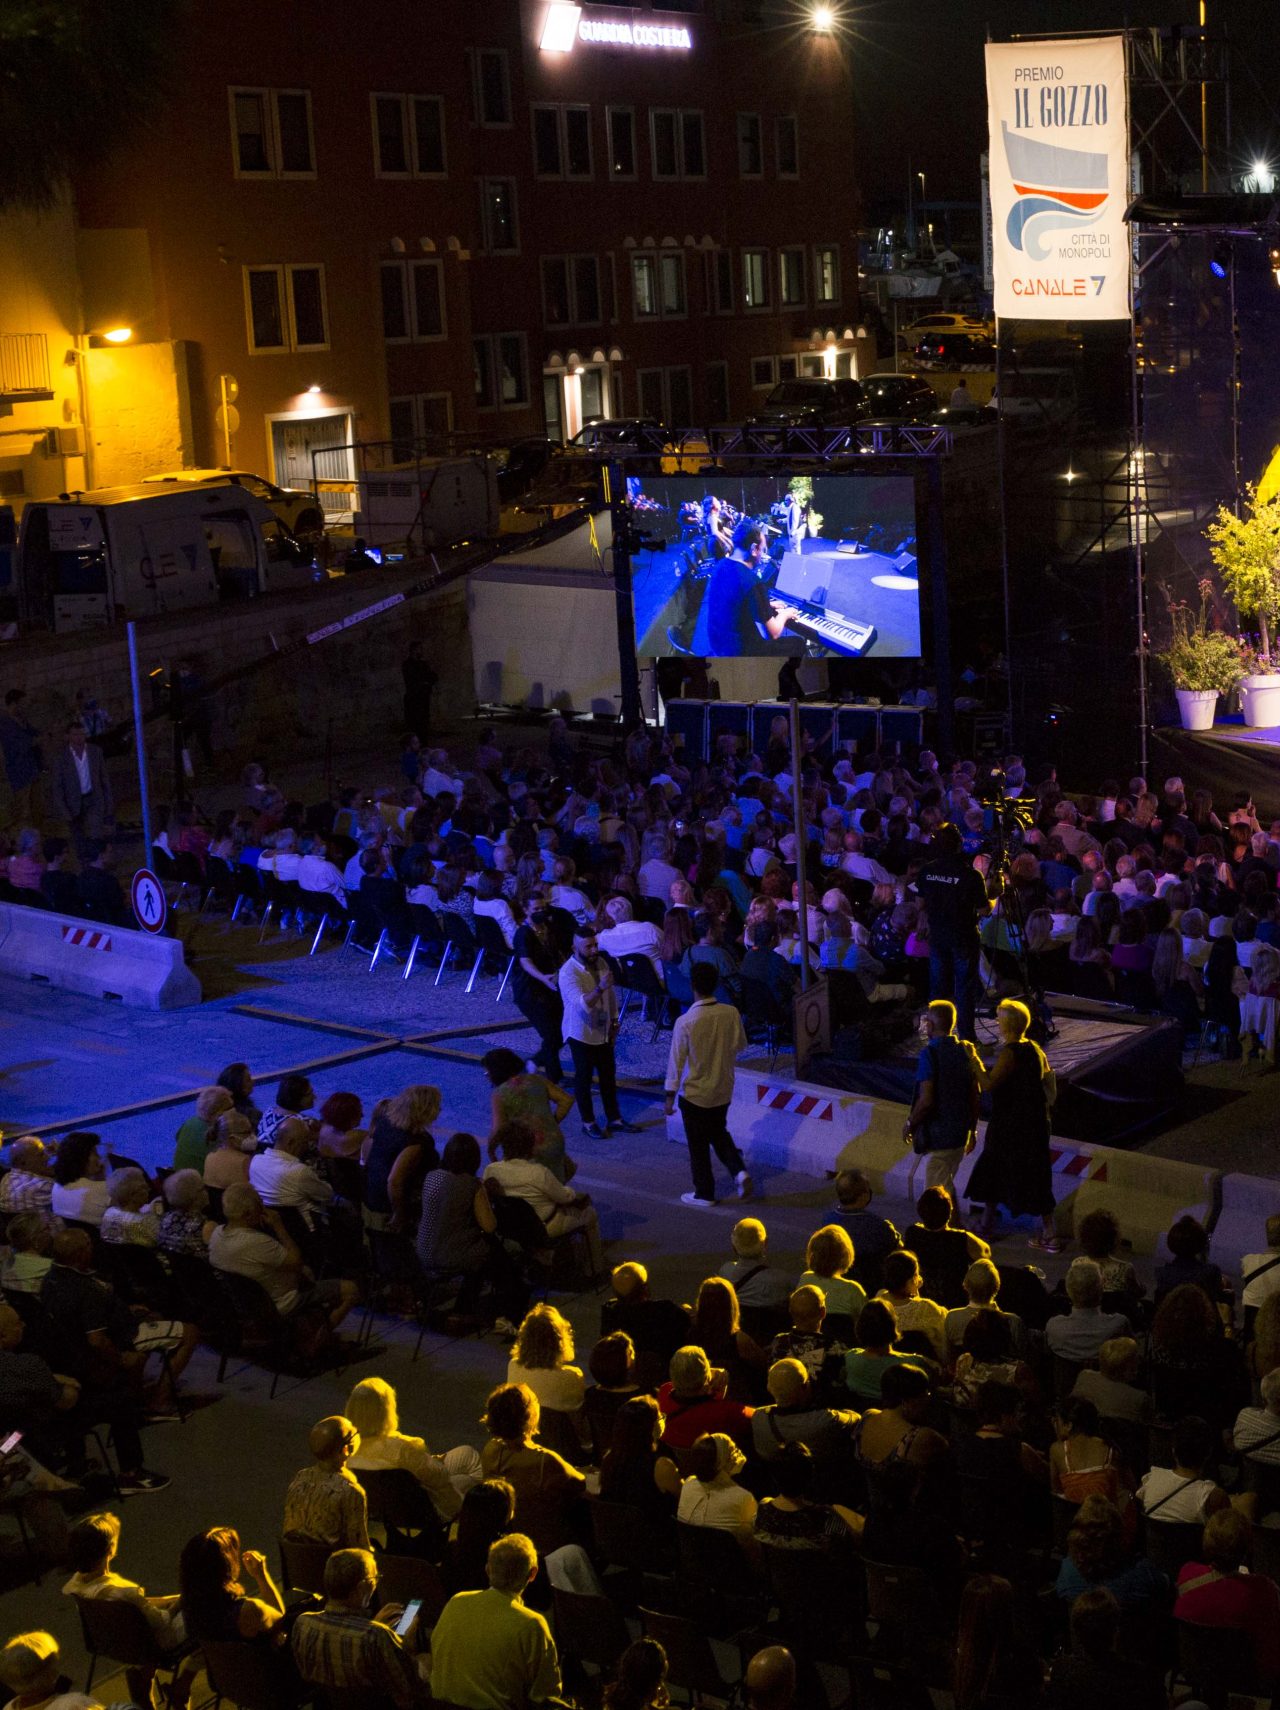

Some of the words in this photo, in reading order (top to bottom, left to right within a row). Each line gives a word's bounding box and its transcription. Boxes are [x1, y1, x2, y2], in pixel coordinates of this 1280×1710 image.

[633, 25, 691, 48] COSTIERA
[1014, 65, 1064, 82] PREMIO
[1014, 87, 1034, 129] IL
[1039, 83, 1108, 128] GOZZO
[1071, 231, 1097, 246] CITTÀ
[1099, 233, 1110, 245] DI
[1058, 247, 1111, 259] MONOPOLI
[1011, 278, 1086, 296] CANALE
[1090, 276, 1106, 296] 7
